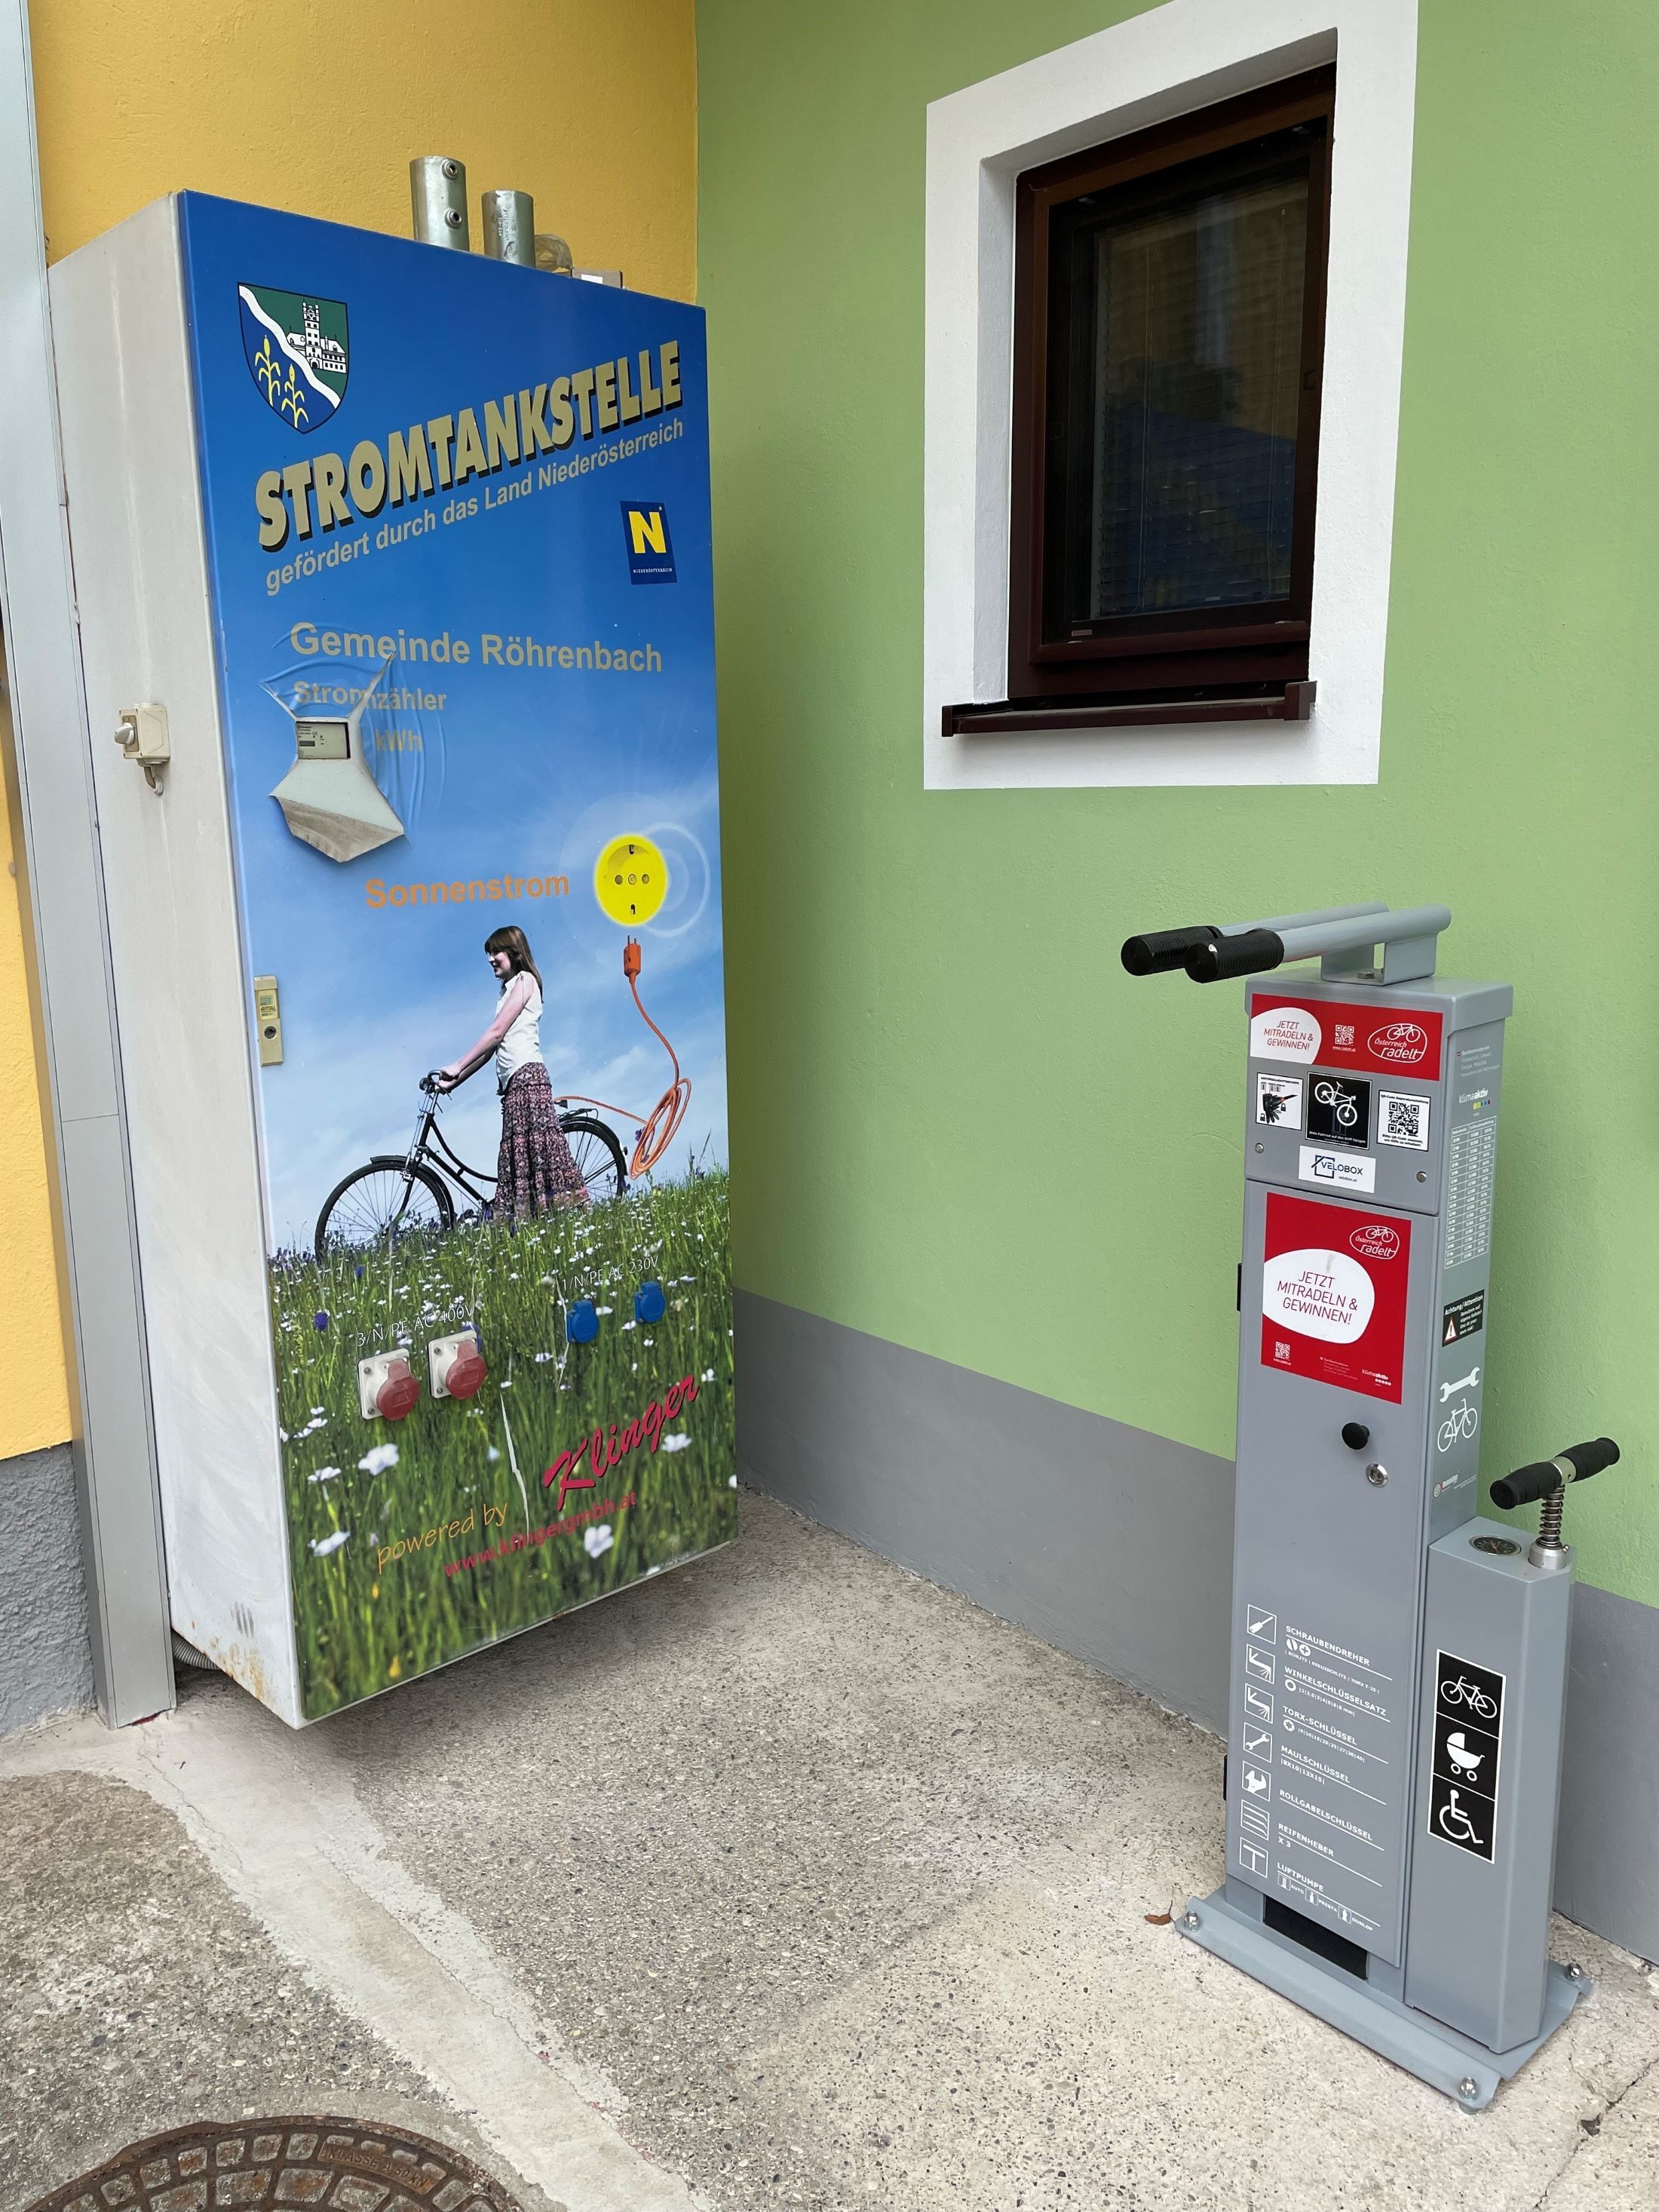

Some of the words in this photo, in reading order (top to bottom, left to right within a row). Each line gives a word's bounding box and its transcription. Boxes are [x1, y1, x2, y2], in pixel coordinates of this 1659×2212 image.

[256, 340, 682, 553] STROMTANKSTELLE
[266, 531, 370, 597] gefördert
[376, 508, 436, 550] durch
[443, 499, 478, 525] das
[485, 472, 532, 510] Land
[538, 418, 683, 490] Niederösterreich
[629, 511, 667, 554] N
[290, 621, 471, 664] Gemeinde
[481, 634, 662, 672] Röhrenbach
[294, 681, 446, 710] Stromzähler
[376, 729, 422, 752] kWh
[365, 873, 570, 909] Sonnenstrom
[1264, 1028, 1307, 1041] MITRADELN
[1308, 1033, 1314, 1042] &
[1277, 1020, 1300, 1029] JETZT
[1267, 1038, 1311, 1051] GEWINNEN!
[1374, 1036, 1408, 1048] Österreich
[1381, 1048, 1423, 1060] radelt
[1321, 1161, 1363, 1175] VELOBOX
[1355, 1235, 1383, 1247] Österreich
[1361, 1244, 1395, 1257] radelt
[562, 1269, 604, 1291] 1/N/PE
[609, 1263, 625, 1279] AC
[630, 1255, 658, 1274] 230V
[1299, 1271, 1335, 1289] JETZT
[1277, 1281, 1346, 1308] MITRADELN
[1348, 1298, 1357, 1311] &
[1283, 1297, 1352, 1324] GEWINNEN!
[357, 1321, 409, 1347] 3/N/PE
[414, 1313, 434, 1331] AC
[439, 1303, 475, 1324] 400V
[544, 1375, 699, 1511] Klinger
[376, 1509, 475, 1574] powered
[483, 1502, 508, 1527] by
[443, 1490, 636, 1577] www.klingergmbh.at
[1285, 1625, 1370, 1667] SCHRAUBENDREHER
[1288, 1651, 1308, 1663] SCHLITZ
[1284, 1665, 1387, 1717] WINKELSCHLÜSSELSATZ
[1283, 1705, 1357, 1746] TORX-SCHLÜSSEL
[1280, 1744, 1351, 1784] MAULSCHLÜSSEL
[1279, 1789, 1372, 1841] ROLLGABELSCHLÜSSEL
[1278, 1823, 1335, 1857] REIFENHEBER
[1278, 1836, 1284, 1845] X
[1277, 1861, 1324, 1892] LUFTPUMPE
[1290, 1883, 1305, 1894] AUTO
[1318, 1898, 1338, 1913] PRESTA
[1351, 1916, 1373, 1931] DUNLOP
[328, 2148, 378, 2168] KLASSE
[382, 2161, 392, 2173] A
